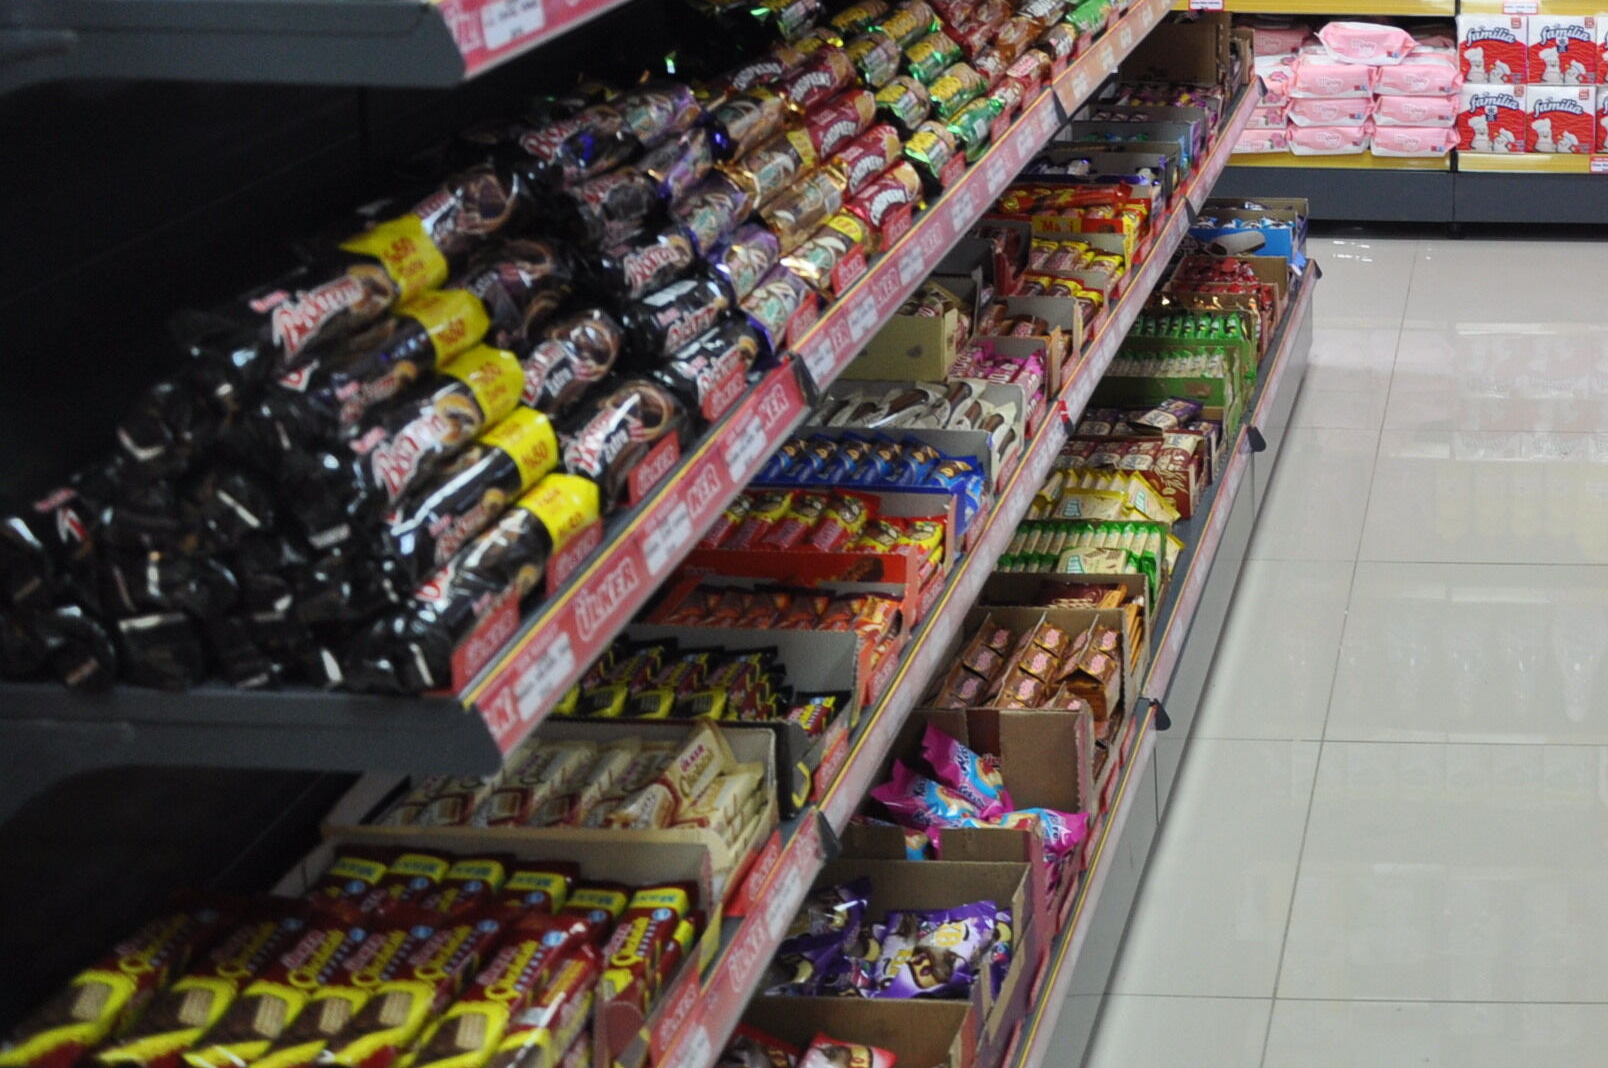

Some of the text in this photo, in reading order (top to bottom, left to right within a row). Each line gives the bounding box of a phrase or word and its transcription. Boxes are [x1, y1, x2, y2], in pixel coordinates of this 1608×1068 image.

[1466, 26, 1514, 46] familia
[1541, 24, 1590, 44] familia
[1469, 92, 1519, 112] familia
[1533, 97, 1583, 117] familia
